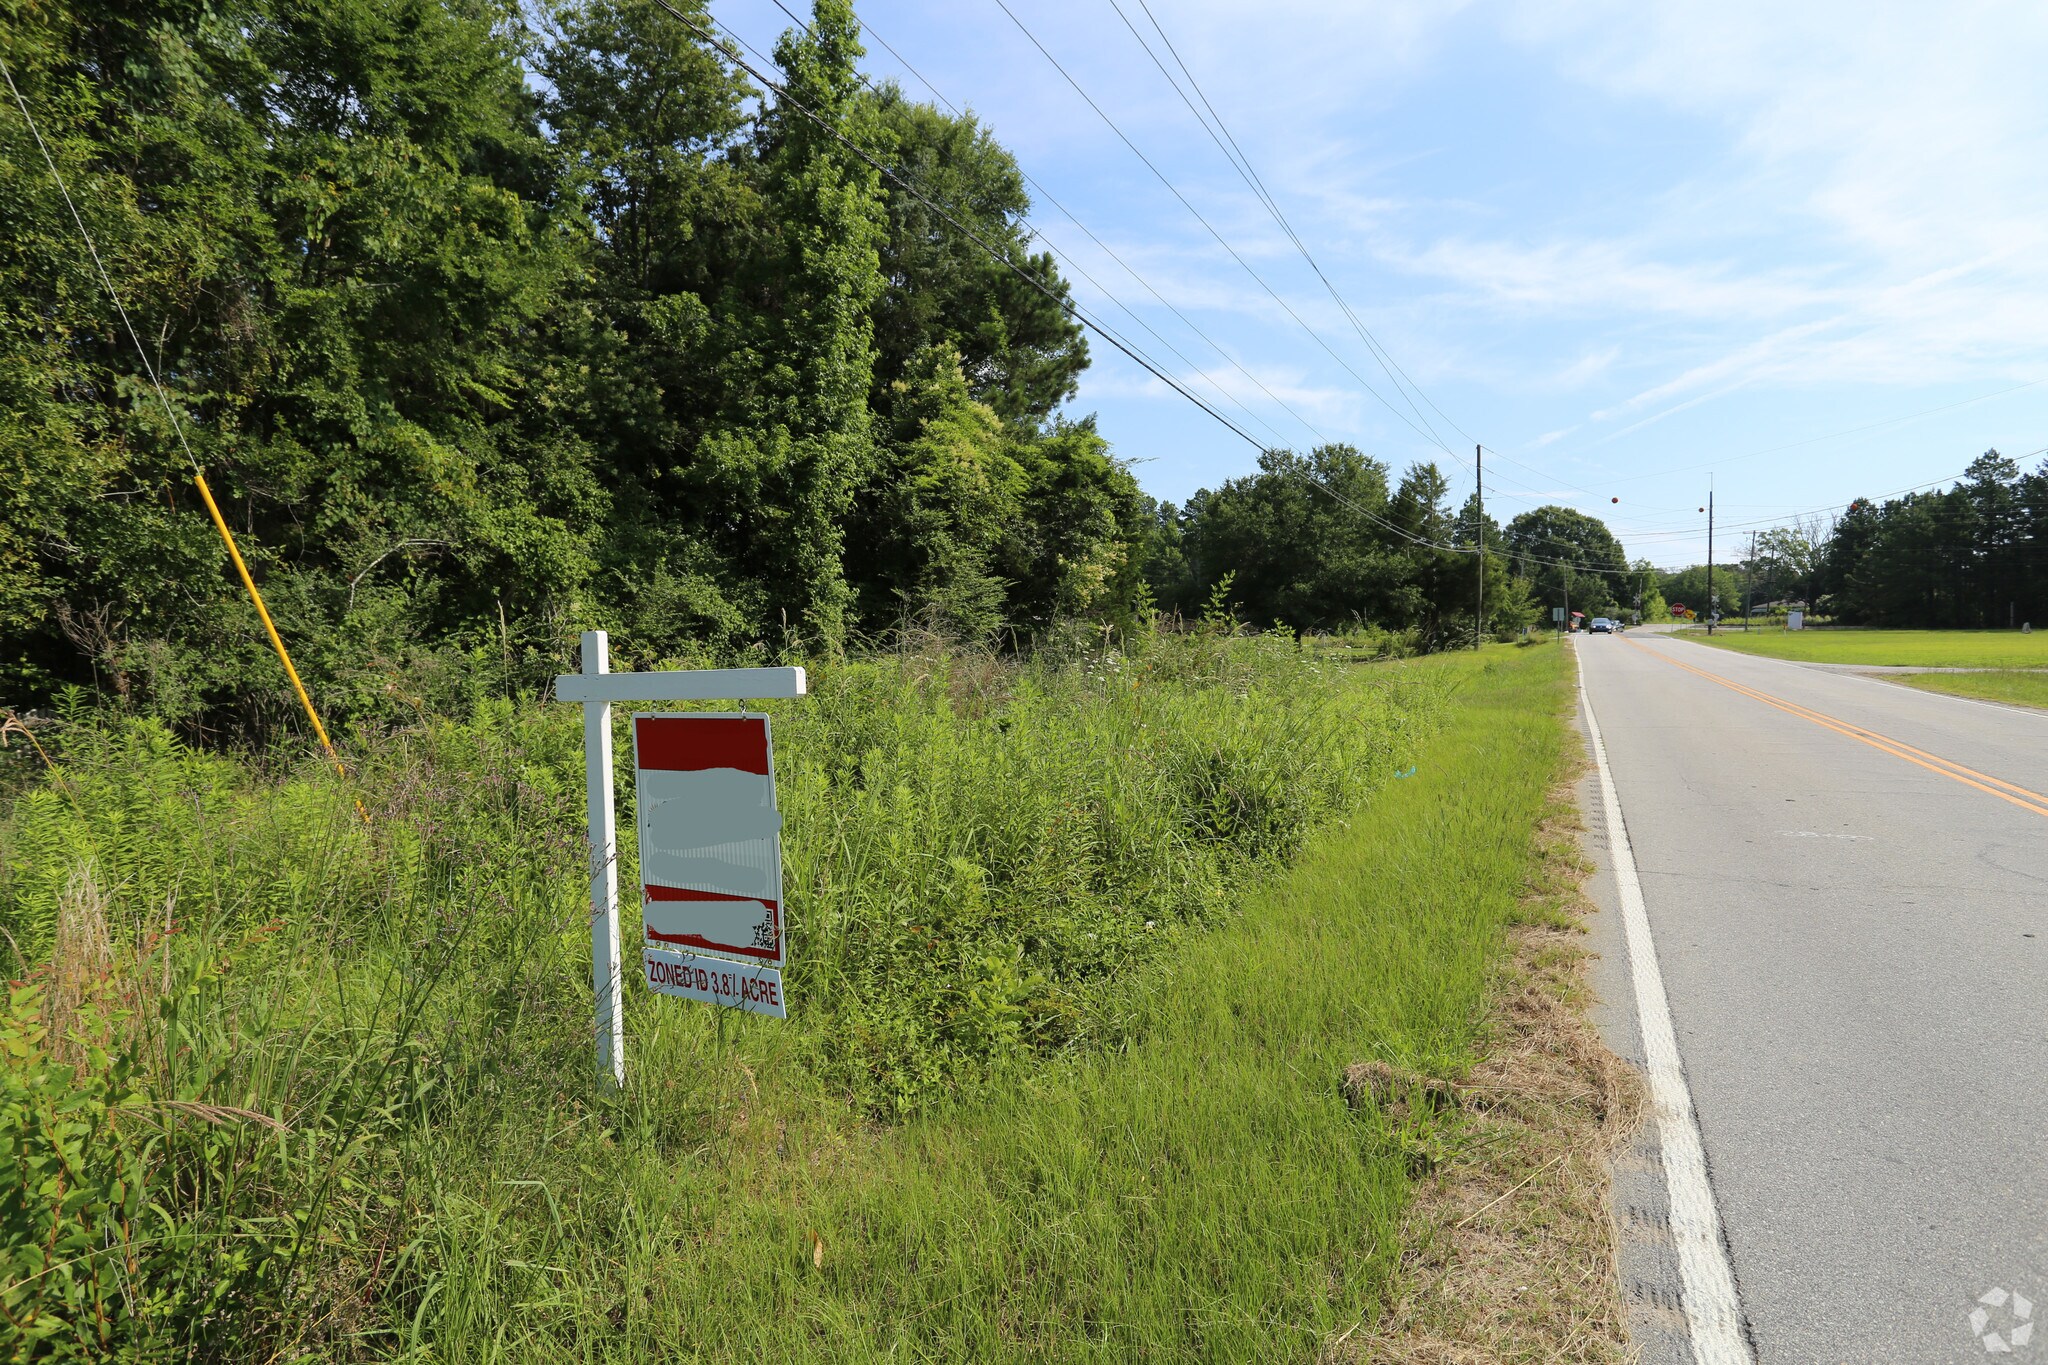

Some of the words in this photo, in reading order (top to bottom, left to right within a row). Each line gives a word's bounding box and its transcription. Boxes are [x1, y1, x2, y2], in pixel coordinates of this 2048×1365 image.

[648, 960, 692, 988] ZONED
[695, 967, 708, 992] ID
[742, 976, 778, 1006] ACRE
